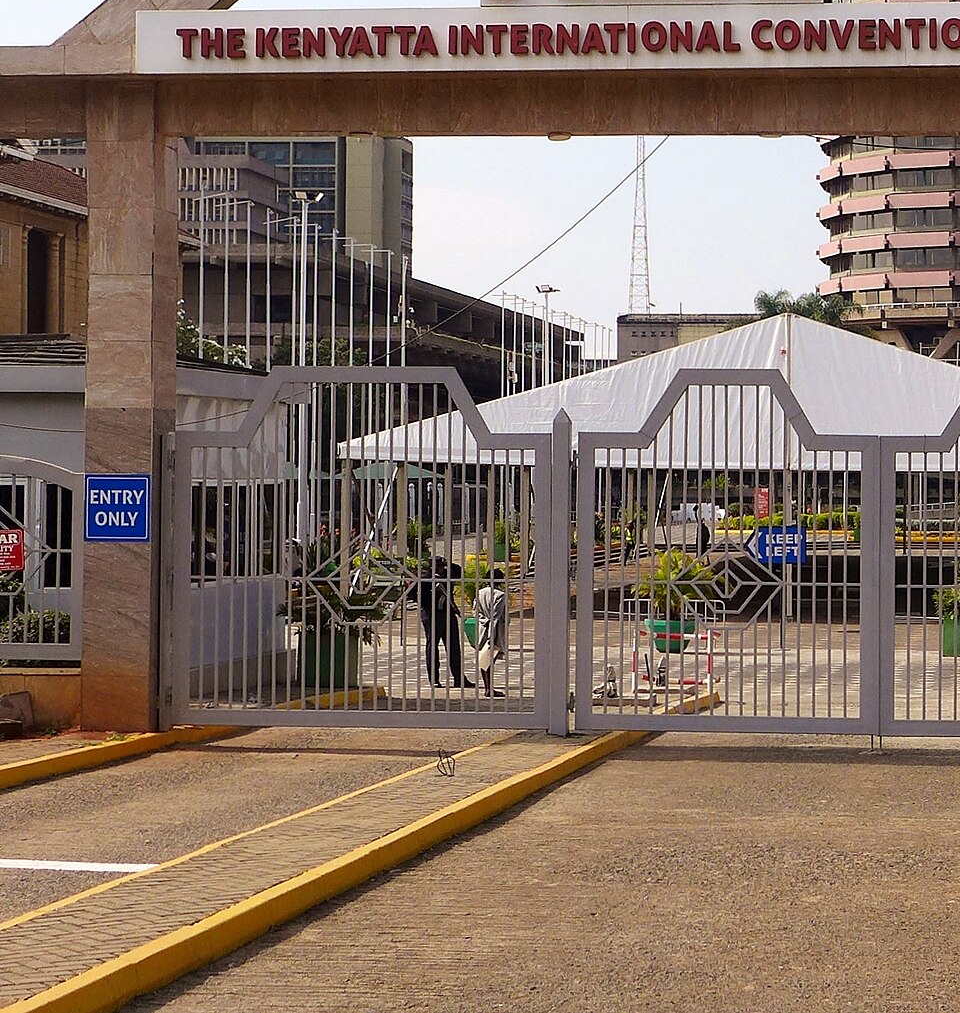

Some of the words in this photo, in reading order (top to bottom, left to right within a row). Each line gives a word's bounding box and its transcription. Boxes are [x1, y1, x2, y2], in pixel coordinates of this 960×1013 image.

[176, 27, 246, 60] THE
[255, 25, 439, 59] KENYATTA
[448, 19, 741, 57] INTERNATIONAL
[90, 489, 145, 505] ENTRY
[95, 511, 139, 527] ONLY
[765, 534, 803, 544] KEEP
[765, 546, 799, 557] LEFT
